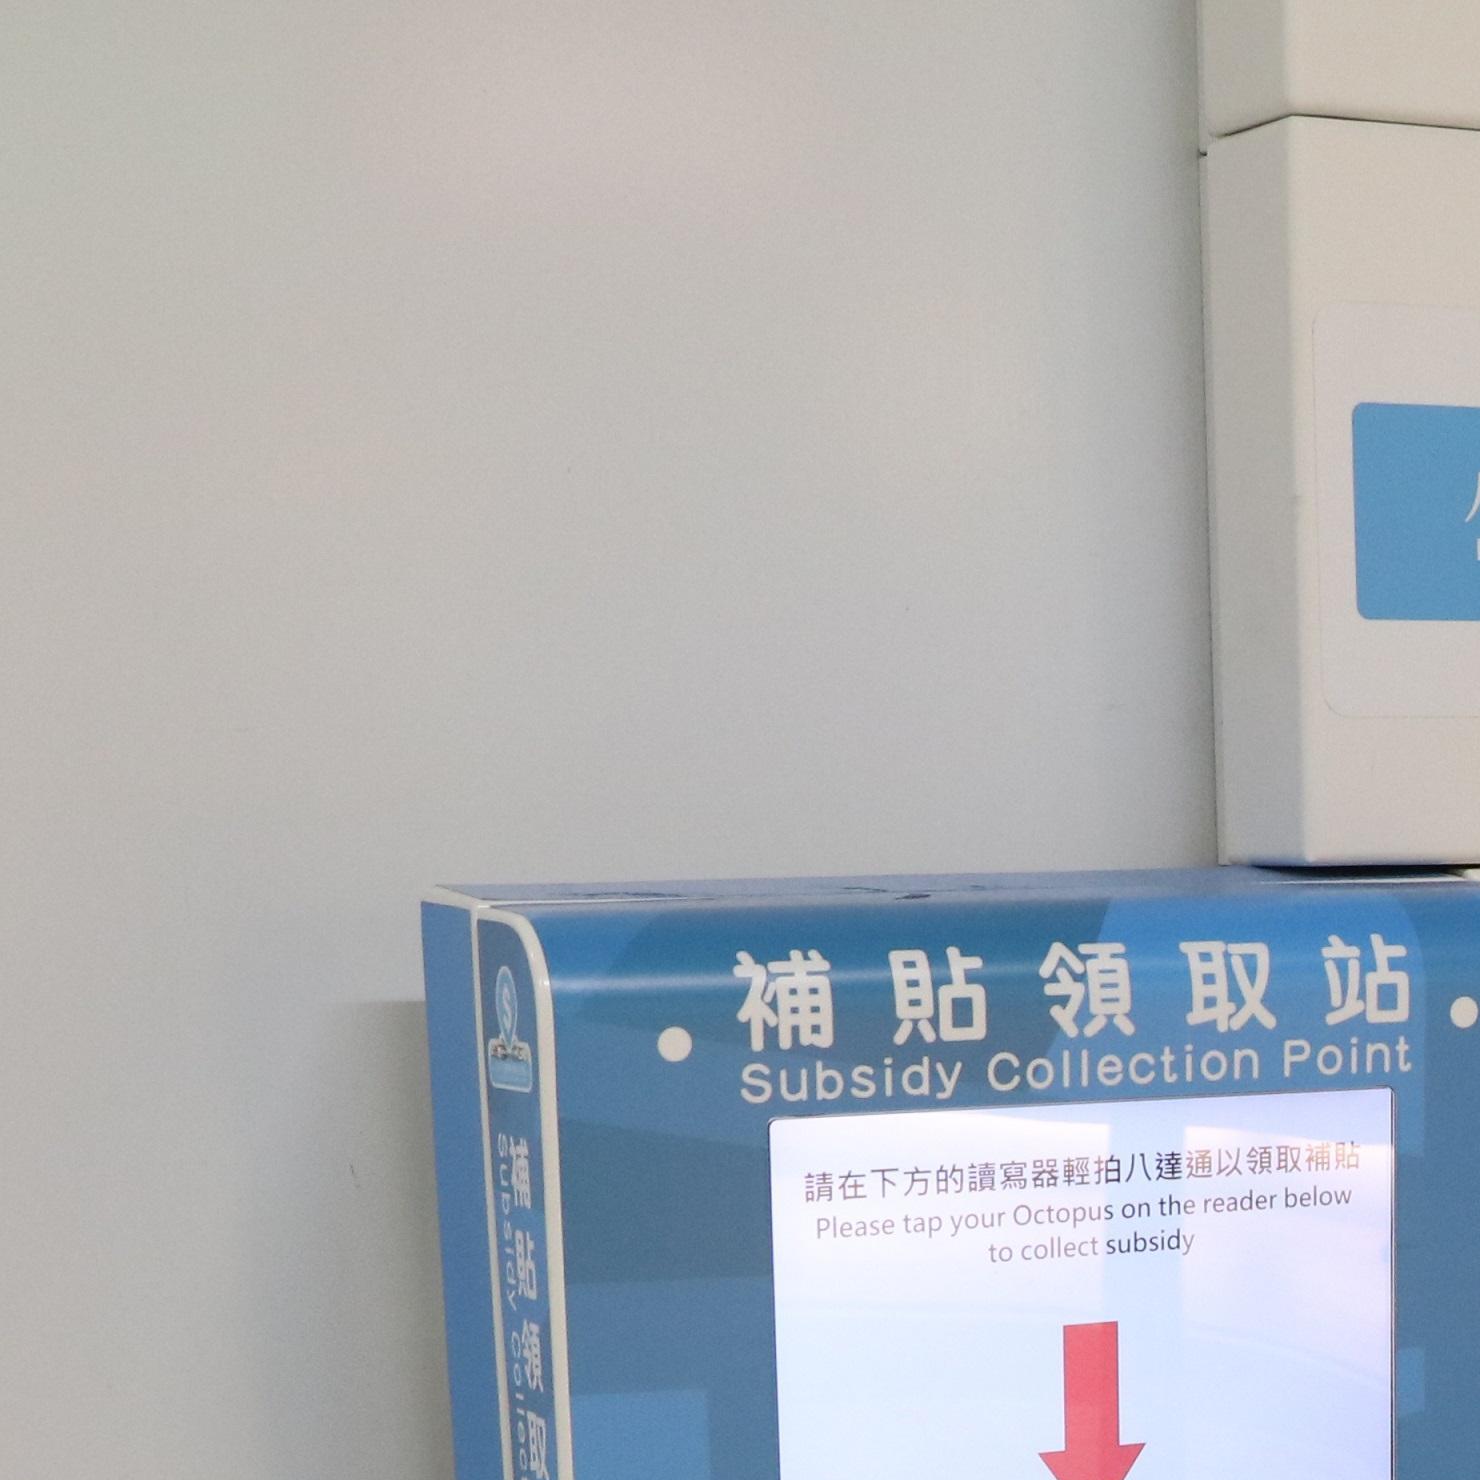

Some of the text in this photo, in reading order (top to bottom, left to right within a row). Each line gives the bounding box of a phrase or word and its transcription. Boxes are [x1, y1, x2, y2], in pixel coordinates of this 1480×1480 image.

[736, 934, 1411, 1053] 補貼領取站
[741, 1036, 1411, 1104] Subsidy Collection Point
[804, 1142, 1360, 1204] 請在下方的讀寫器輕拍八達通以領取補貼
[817, 1185, 1351, 1239] Please tap your Octopus on the reader below
[989, 1228, 1193, 1263] to collect subsidy
